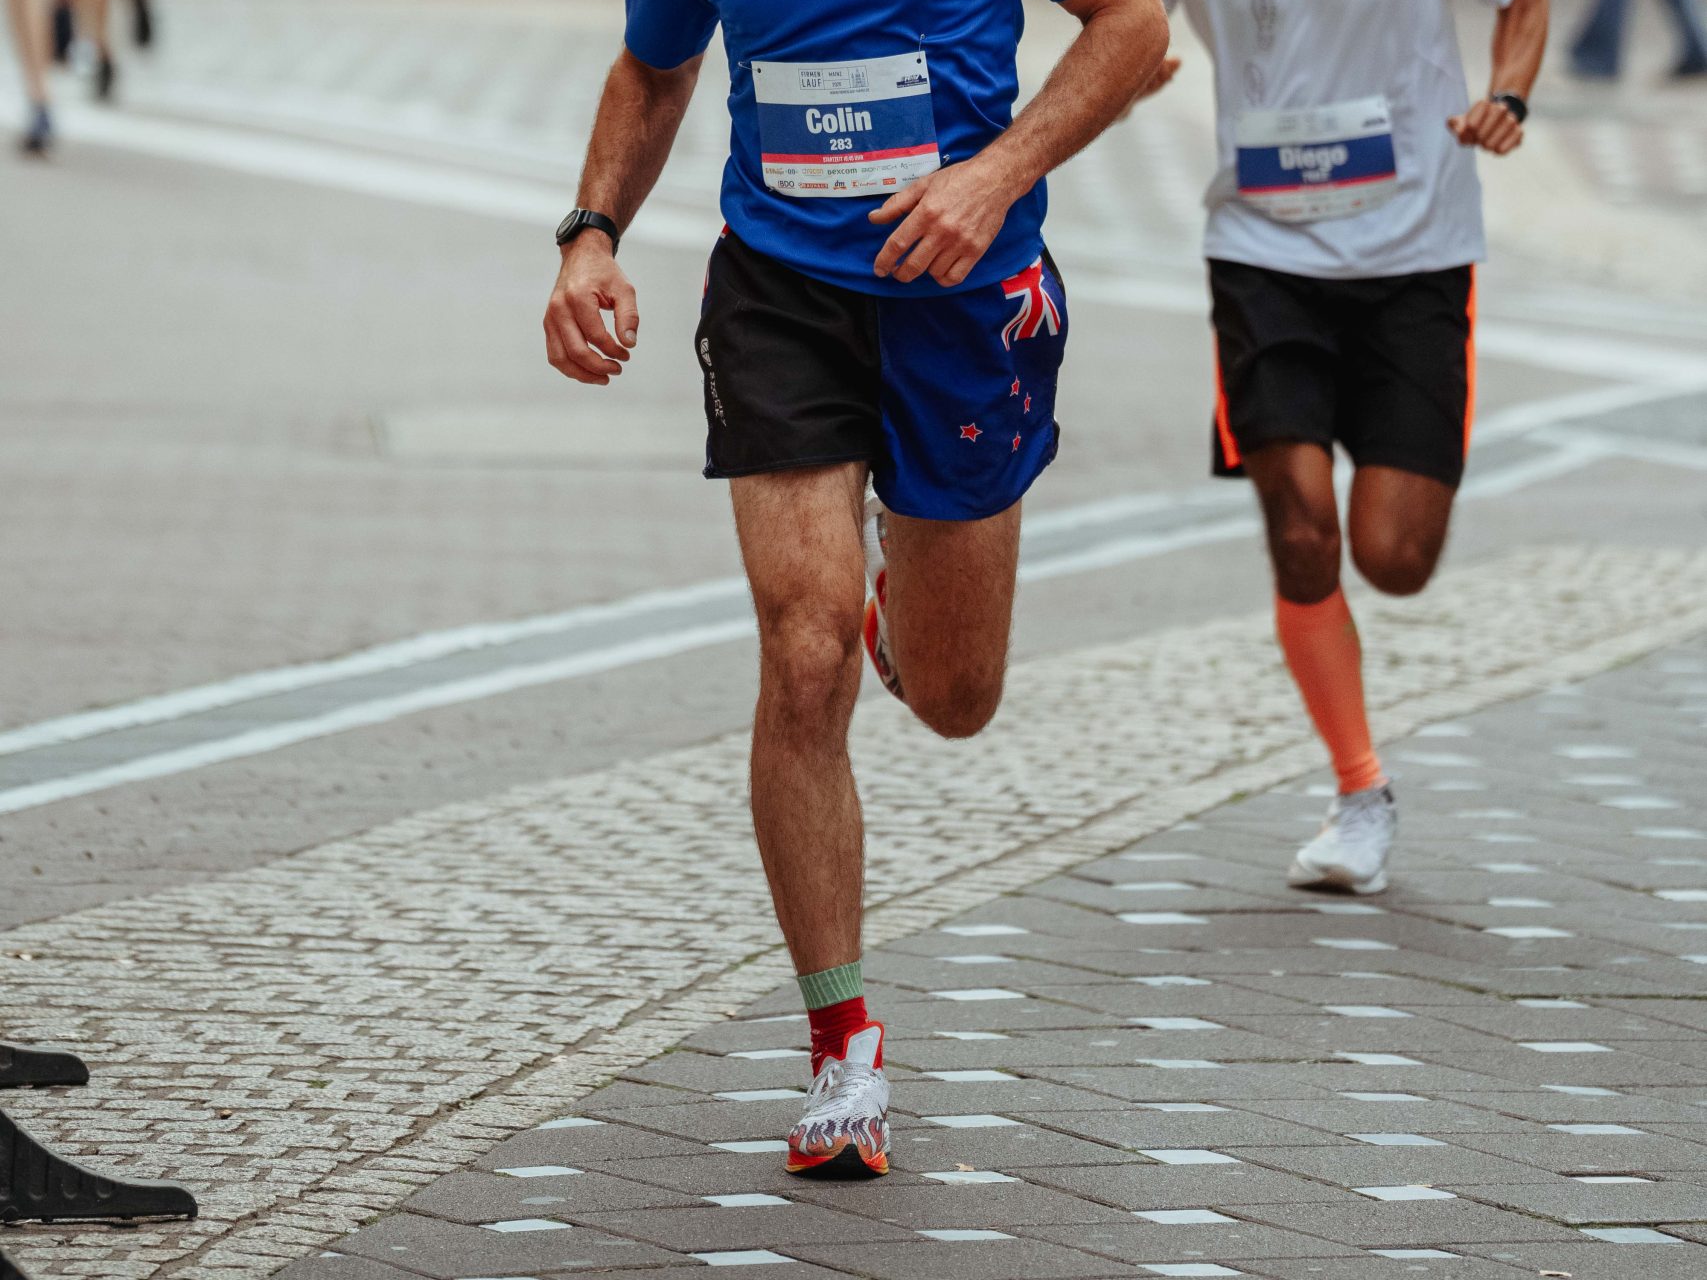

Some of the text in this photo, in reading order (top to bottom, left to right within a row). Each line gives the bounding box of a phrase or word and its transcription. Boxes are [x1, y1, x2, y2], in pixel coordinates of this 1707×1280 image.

[801, 78, 822, 88] LAUF
[805, 106, 873, 134] Colin
[829, 137, 853, 151] 283
[1278, 144, 1349, 173] Diego
